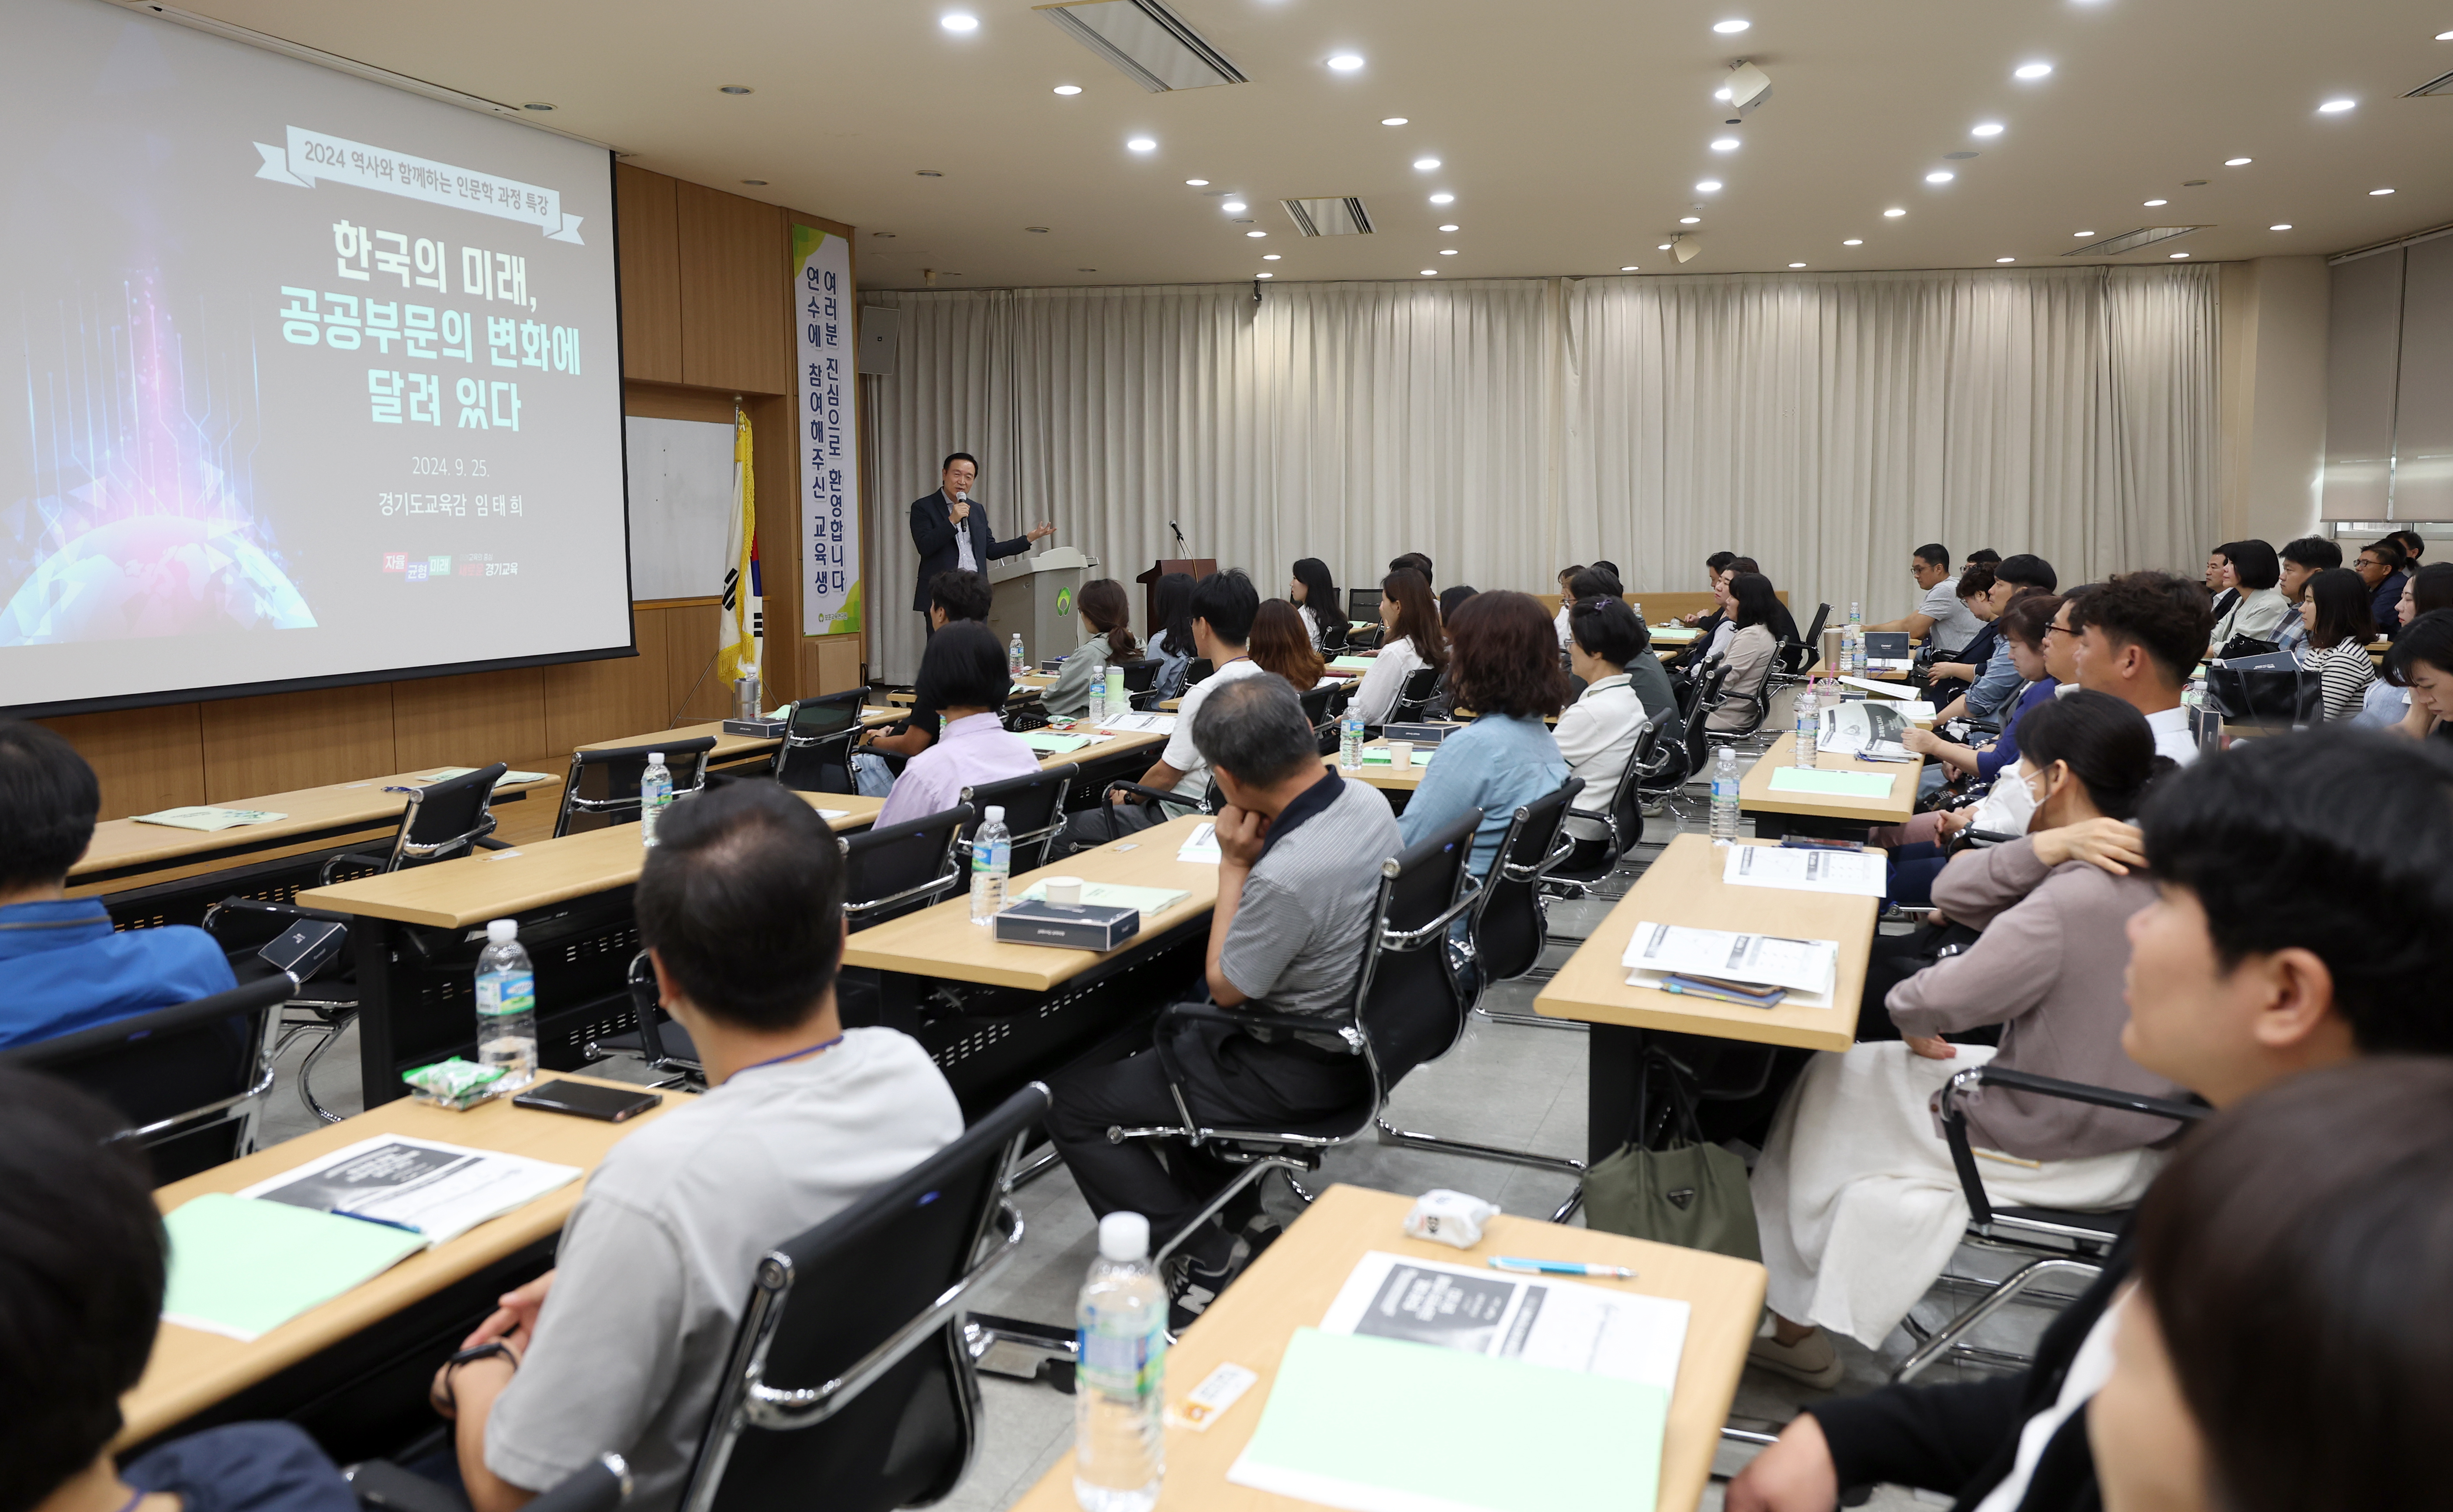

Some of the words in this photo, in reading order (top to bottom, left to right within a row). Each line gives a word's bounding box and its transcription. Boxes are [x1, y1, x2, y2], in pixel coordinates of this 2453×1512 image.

[305, 141, 345, 168] 2024
[351, 150, 393, 181] 역사와
[398, 162, 451, 194] 함께하는
[457, 175, 493, 203] 인문학
[498, 186, 521, 210] 과정
[526, 192, 548, 216] 특강
[333, 219, 447, 294] 한국의
[462, 246, 537, 313] 미래,
[280, 285, 473, 363] 공공부문의
[487, 315, 581, 375] 변화에
[824, 271, 838, 346] 여러분
[368, 369, 441, 426] 달려
[456, 377, 522, 432] 있다
[807, 266, 821, 348] 연수에
[814, 516, 828, 595] 교육생
[826, 357, 841, 457] 진심으로
[412, 456, 451, 476] 2024.
[455, 458, 467, 477] 9.
[471, 459, 490, 477] 25.
[379, 491, 467, 516] 경기도교육감
[829, 468, 845, 592] 환영합니다
[385, 554, 405, 570] 자율
[408, 564, 427, 579] 균형
[430, 558, 450, 572] 미래
[485, 562, 518, 576] 경기교육
[1177, 1283, 1216, 1315] N
